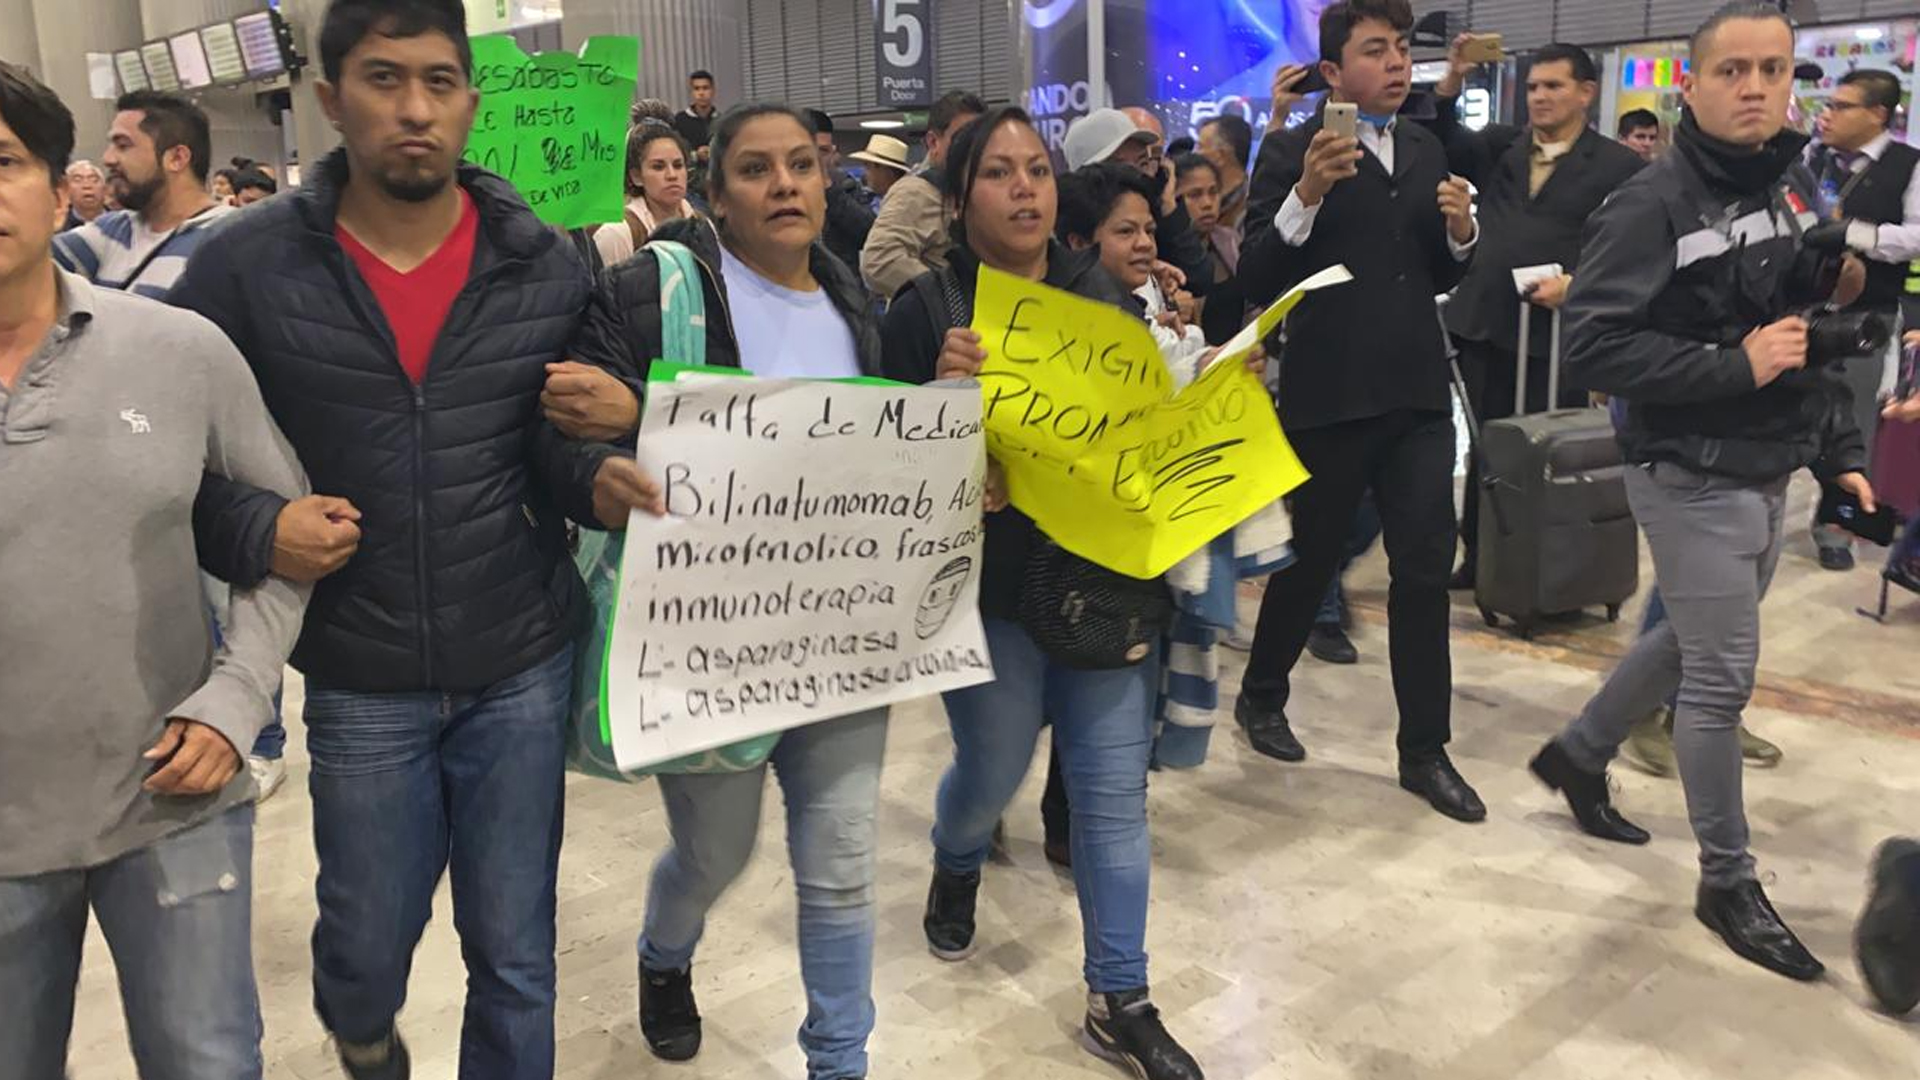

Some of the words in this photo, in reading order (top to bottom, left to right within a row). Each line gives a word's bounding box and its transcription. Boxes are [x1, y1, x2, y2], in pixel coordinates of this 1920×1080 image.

[882, 0, 924, 67] 5
[882, 76, 925, 90] Puerta
[889, 89, 917, 101] Door
[808, 397, 857, 440] de
[649, 580, 896, 625] inmunoterapia
[686, 628, 898, 673] asparaginasa
[686, 666, 889, 718] asparaginasa
